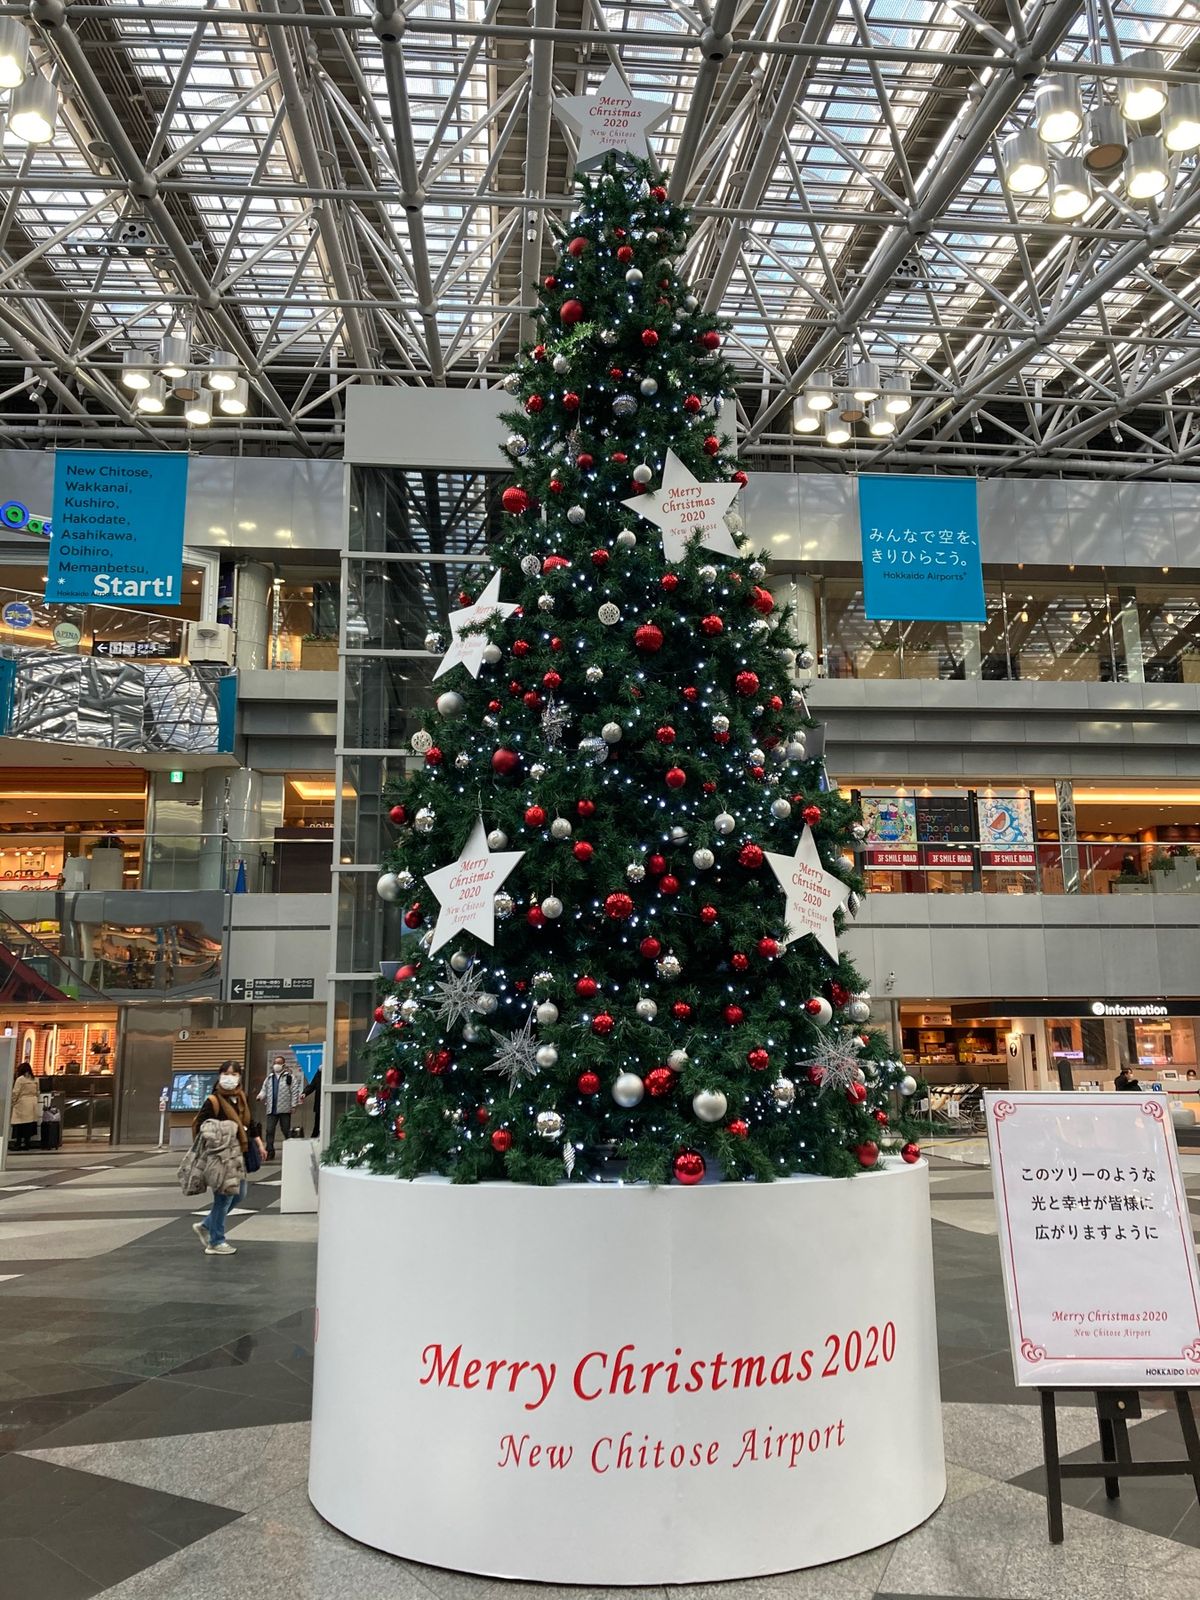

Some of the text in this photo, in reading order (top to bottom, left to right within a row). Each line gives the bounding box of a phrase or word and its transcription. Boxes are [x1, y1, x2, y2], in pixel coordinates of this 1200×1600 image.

[600, 97, 631, 108] Merry
[590, 107, 641, 117] Christmas
[604, 119, 628, 127] 2020
[609, 129, 636, 137] Chitose
[600, 137, 627, 145] Airport
[67, 465, 153, 478] New Chitose,
[65, 482, 132, 493] Wakkanai,
[669, 487, 702, 498] Merry
[65, 497, 119, 509] Kushiro,
[662, 498, 715, 513] Christmas
[63, 513, 130, 525] Hakodate,
[680, 511, 705, 523] 2020
[61, 530, 136, 542] Asahikawa,
[671, 528, 687, 536] New
[870, 528, 976, 545] みんなで空を、
[60, 545, 113, 557] Obihiro,
[872, 548, 967, 566] きりひらこう。
[59, 562, 148, 575] Memanbetsu,
[883, 571, 924, 579] Hokkaido
[94, 574, 173, 597] Start!
[885, 854, 902, 862] SMILE
[903, 854, 917, 862] ROAD
[940, 854, 956, 862] SMILE
[958, 854, 971, 862] ROAD
[1002, 854, 1018, 862] SMILE
[1019, 854, 1032, 862] ROAD
[460, 858, 488, 872] Merry
[449, 870, 495, 889] Christmas
[799, 863, 823, 883] Merry
[792, 873, 831, 897] Christmas
[459, 886, 481, 900] 2020
[803, 892, 822, 907] 2020
[446, 901, 485, 915] New Chitose
[793, 902, 828, 922] New Chitose
[452, 912, 477, 925] Airport
[800, 915, 822, 929] Airport
[306, 1055, 311, 1072] 1
[1022, 1168, 1156, 1182] このツリーのような
[1032, 1195, 1154, 1211] 光と幸せが皆様に
[1035, 1225, 1158, 1240] 広がりますように
[1052, 1310, 1168, 1324] Merry Christmas 2020
[1074, 1328, 1151, 1339] New Chitose Airport
[420, 1321, 896, 1411] Merry Christmas 2020
[498, 1418, 846, 1473] New Chitose Airport
